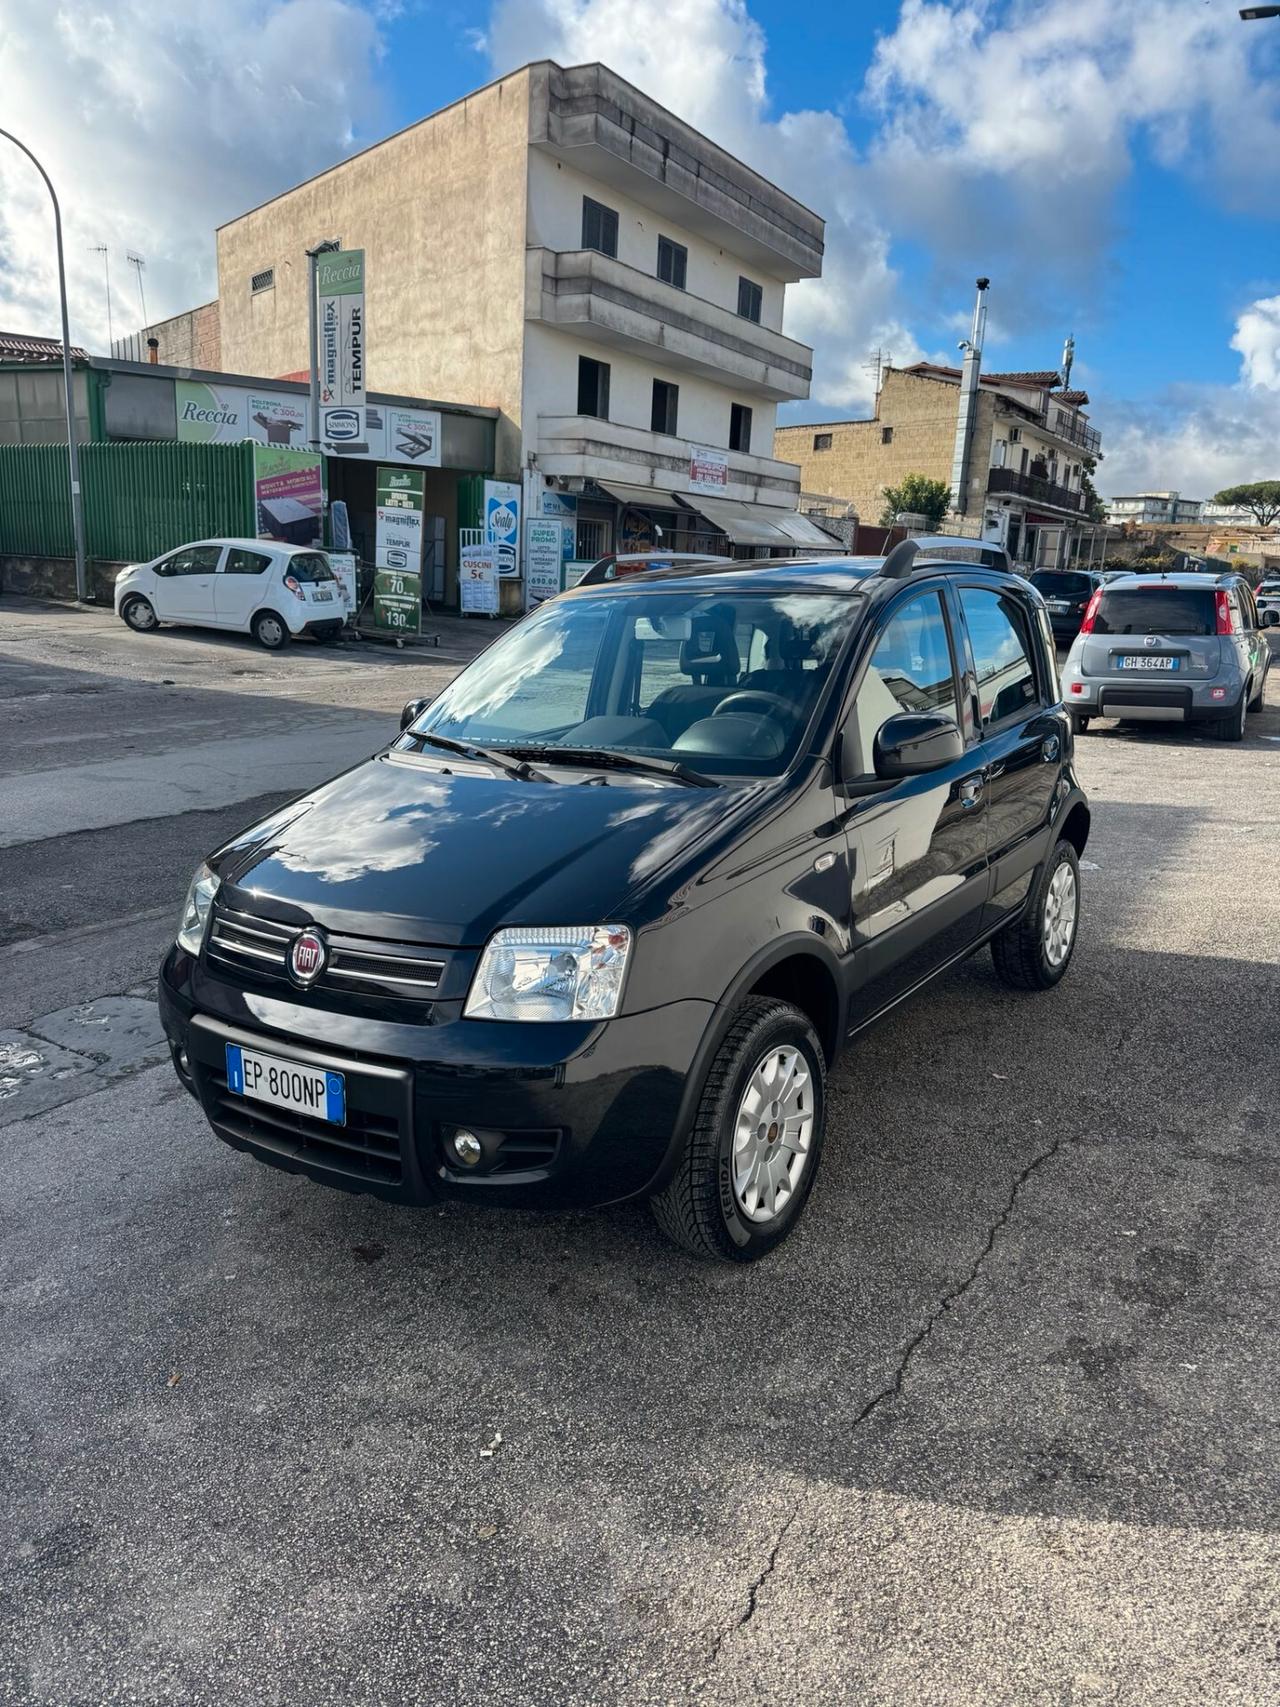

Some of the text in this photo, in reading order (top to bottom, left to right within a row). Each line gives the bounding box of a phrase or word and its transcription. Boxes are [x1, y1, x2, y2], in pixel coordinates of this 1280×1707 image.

[321, 259, 361, 285] Reccia
[324, 301, 337, 384] magniflex
[352, 307, 362, 394] TEMPUR
[182, 400, 239, 426] Reccia
[328, 421, 357, 429] SIMMONS
[385, 514, 420, 529] magniflex
[492, 511, 513, 532] Sealy
[386, 538, 411, 549] TEMPUR
[463, 560, 492, 569] CUSCINI
[390, 579, 404, 594] 70
[387, 611, 406, 627] 130
[1124, 657, 1172, 668] GH 364AP
[298, 945, 318, 968] FIAT
[243, 1058, 263, 1090] EP
[269, 1067, 325, 1108] 800NP
[721, 1156, 735, 1220] KENDA
